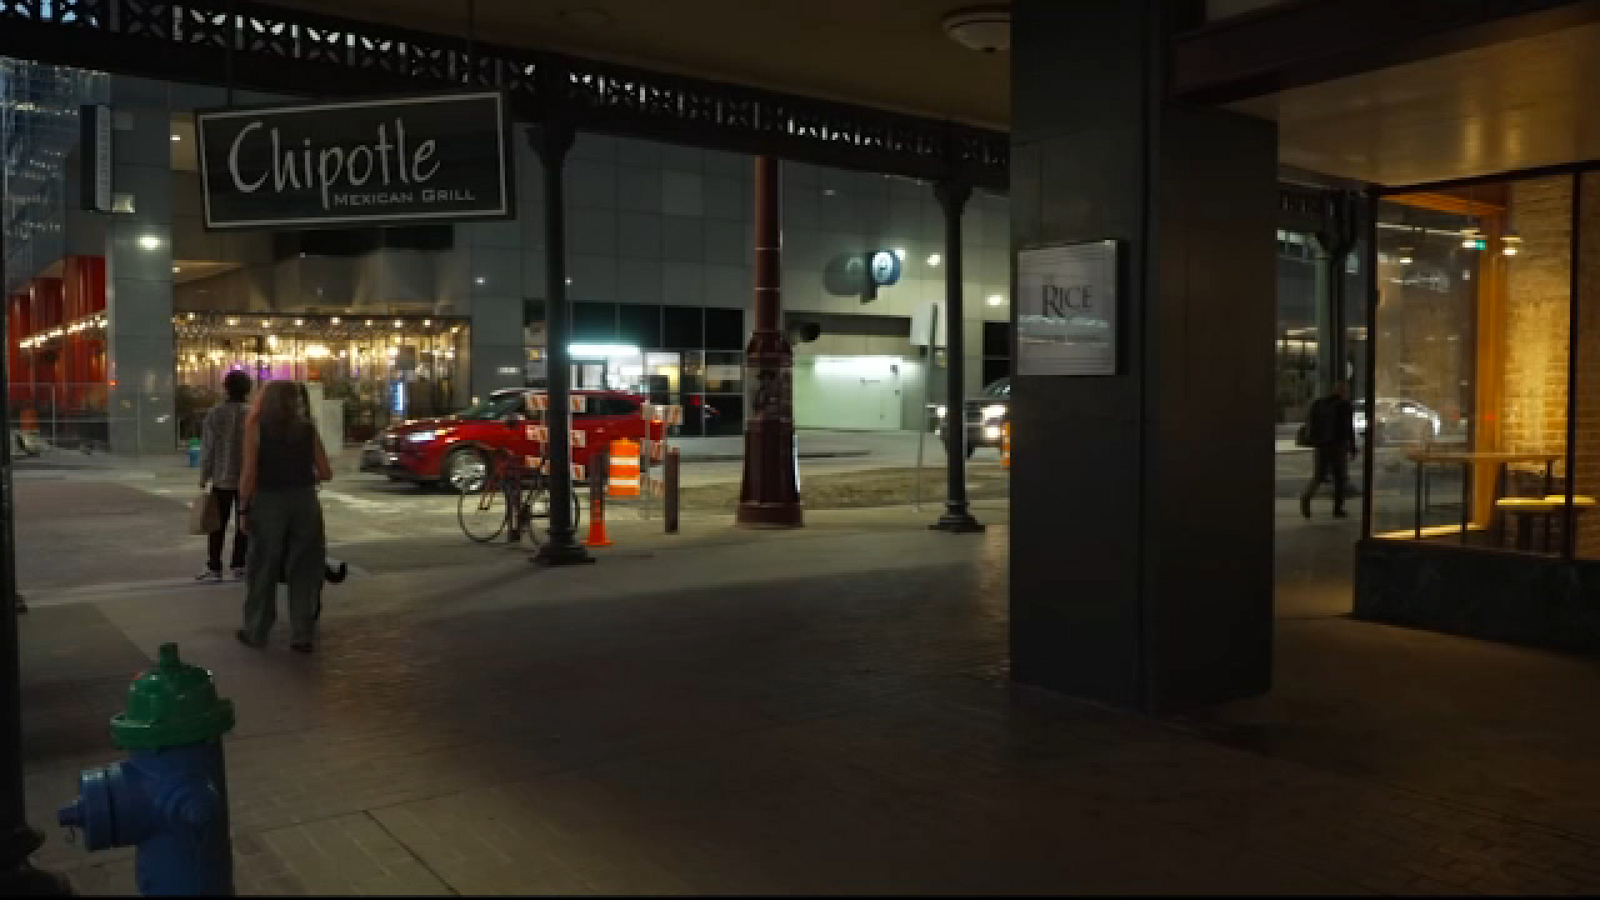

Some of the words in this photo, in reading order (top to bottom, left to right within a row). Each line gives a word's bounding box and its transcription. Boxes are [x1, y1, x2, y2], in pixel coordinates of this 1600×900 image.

[228, 117, 441, 209] Chipotle
[333, 191, 414, 206] MEXICAN
[421, 188, 476, 202] GRILL
[1041, 284, 1094, 318] RICE
